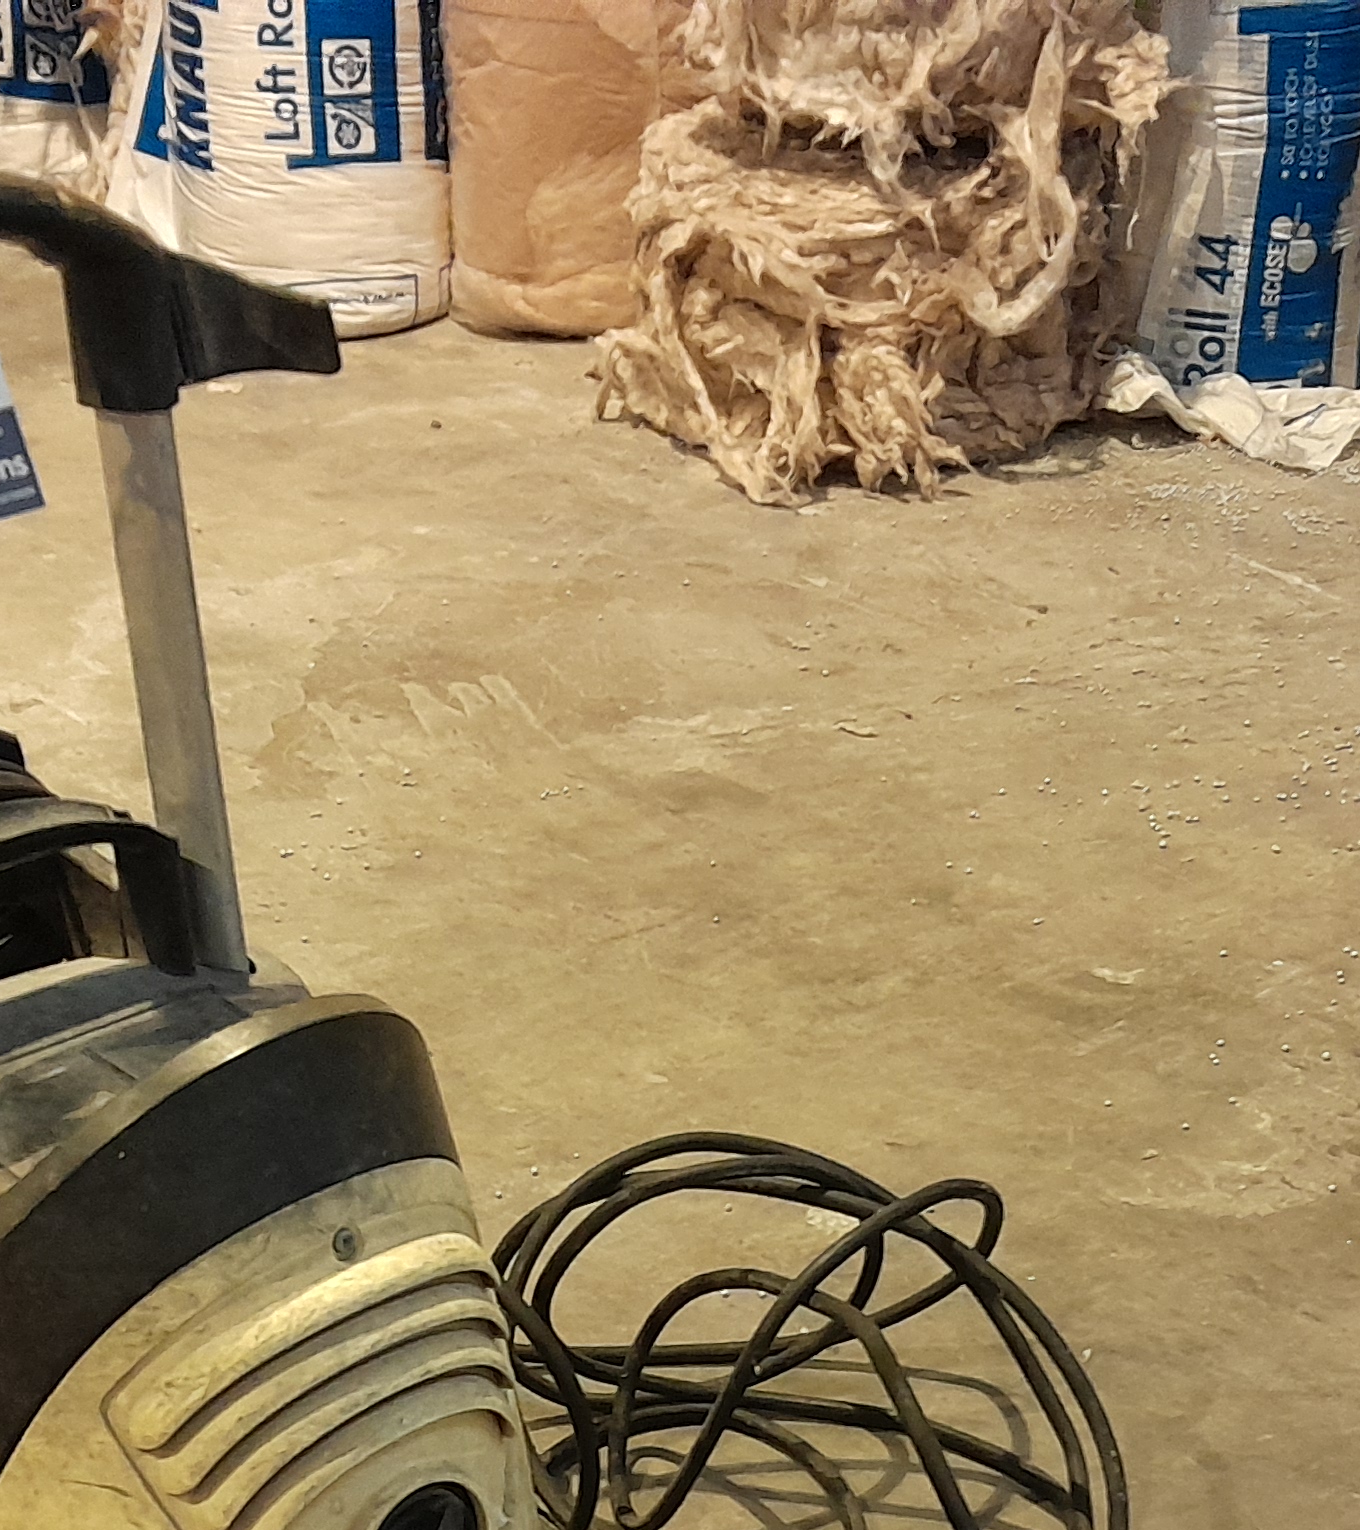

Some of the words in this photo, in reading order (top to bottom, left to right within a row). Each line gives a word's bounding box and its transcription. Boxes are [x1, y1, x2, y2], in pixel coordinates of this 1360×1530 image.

[254, 64, 300, 140] Loft
[1194, 234, 1240, 295] 44
[1260, 242, 1288, 307] ECOSE
